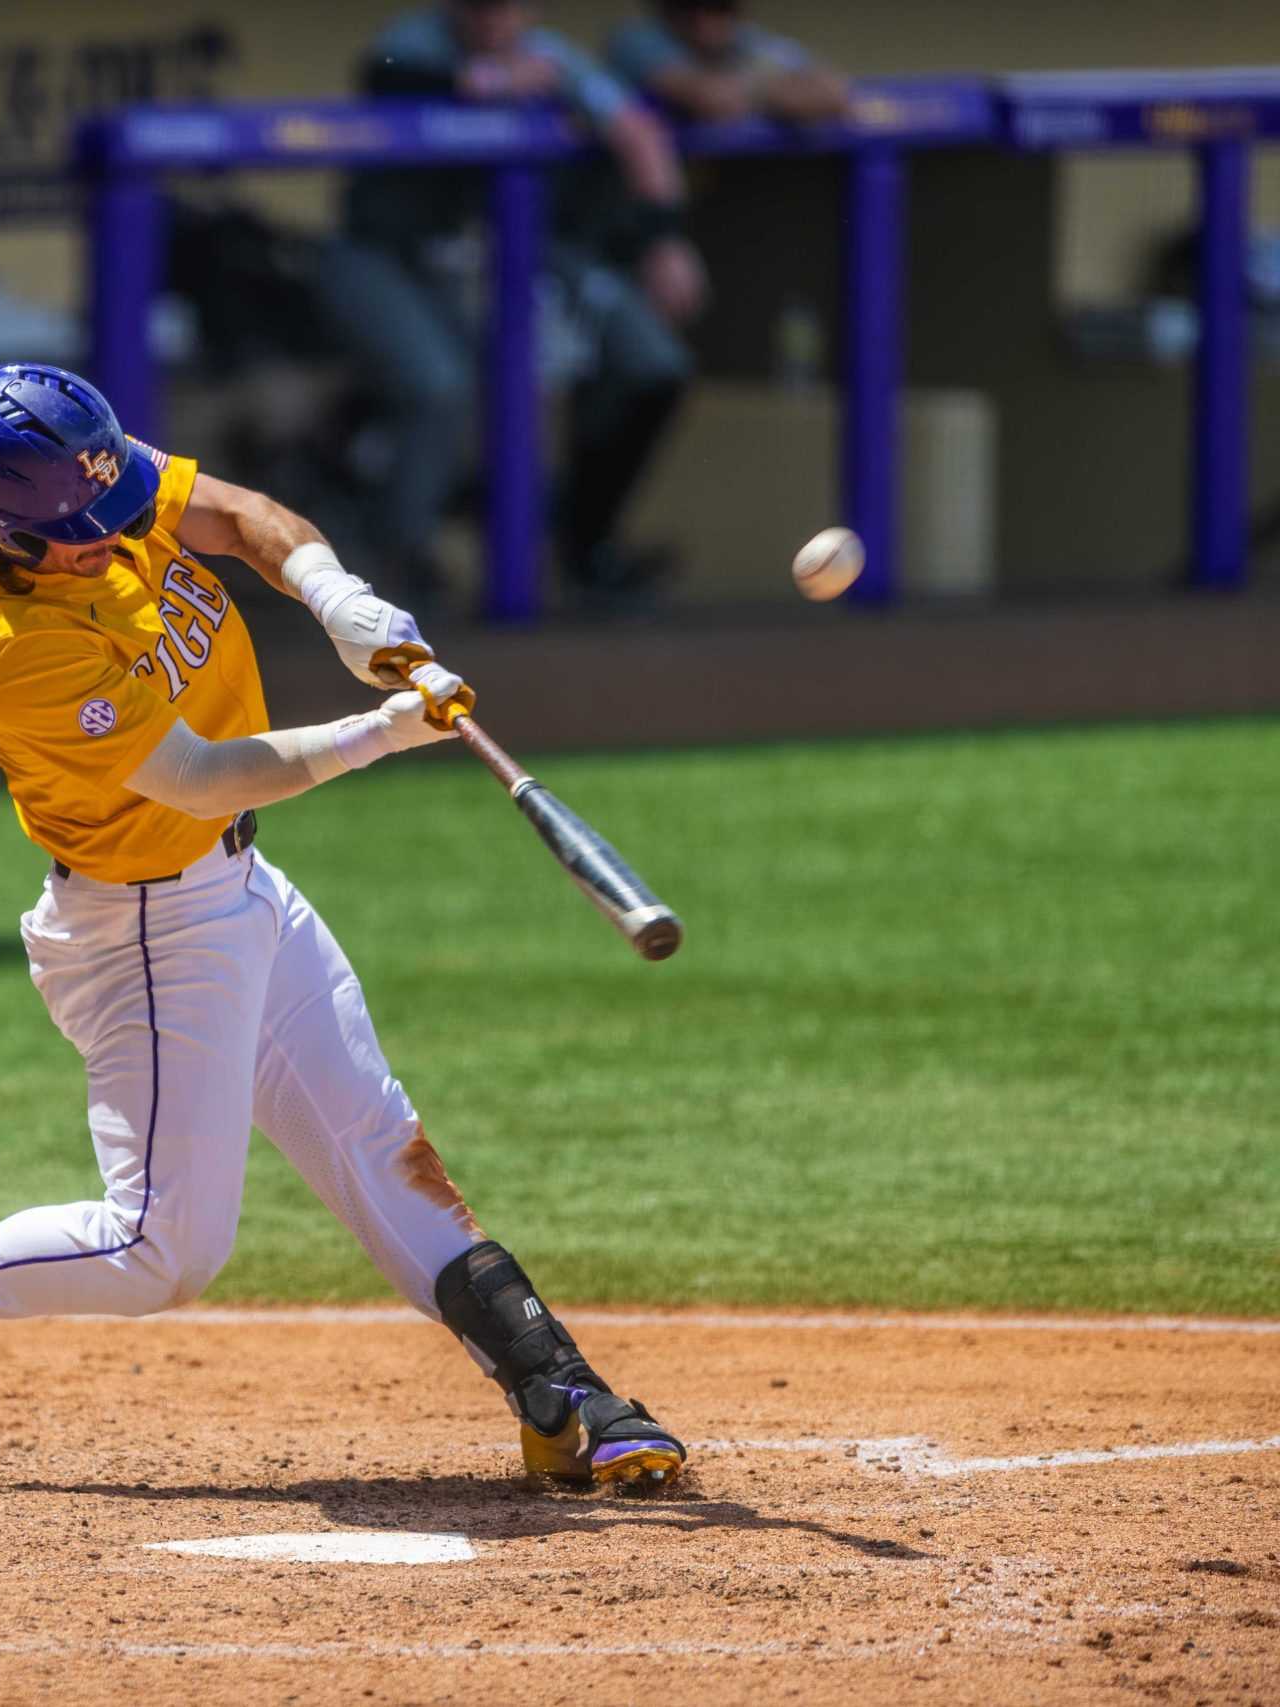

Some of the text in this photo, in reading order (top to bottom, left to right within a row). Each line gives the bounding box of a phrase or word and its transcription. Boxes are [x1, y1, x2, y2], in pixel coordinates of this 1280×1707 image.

[76, 448, 120, 488] LSU
[130, 546, 231, 704] IGE
[80, 700, 114, 735] SEC
